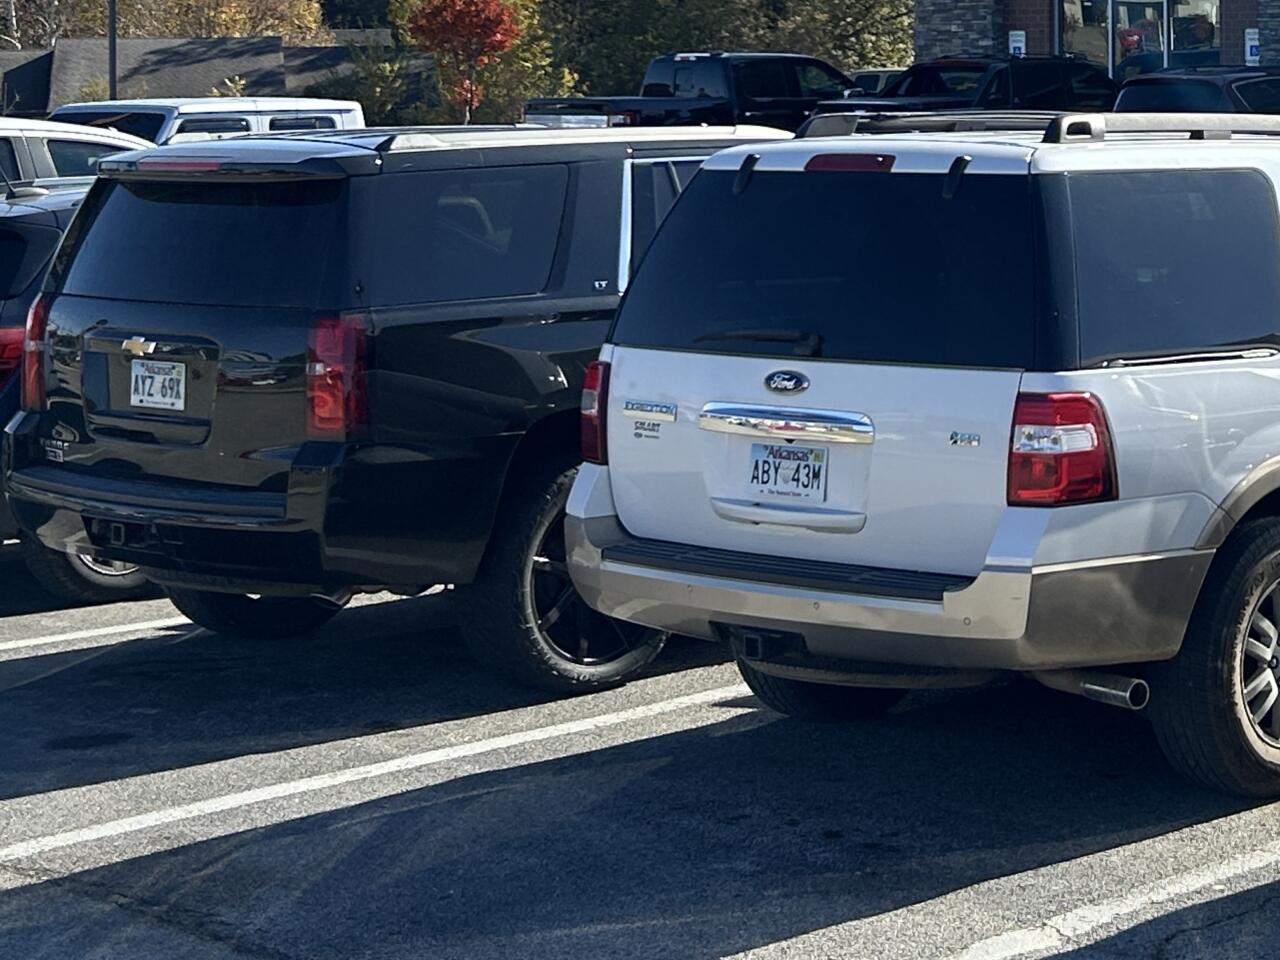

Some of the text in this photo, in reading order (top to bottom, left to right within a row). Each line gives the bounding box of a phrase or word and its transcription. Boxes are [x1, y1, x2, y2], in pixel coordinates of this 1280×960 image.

[133, 374, 182, 400] AYZ 69X
[766, 445, 810, 462] Arkansas
[750, 459, 822, 490] ABY 43M
